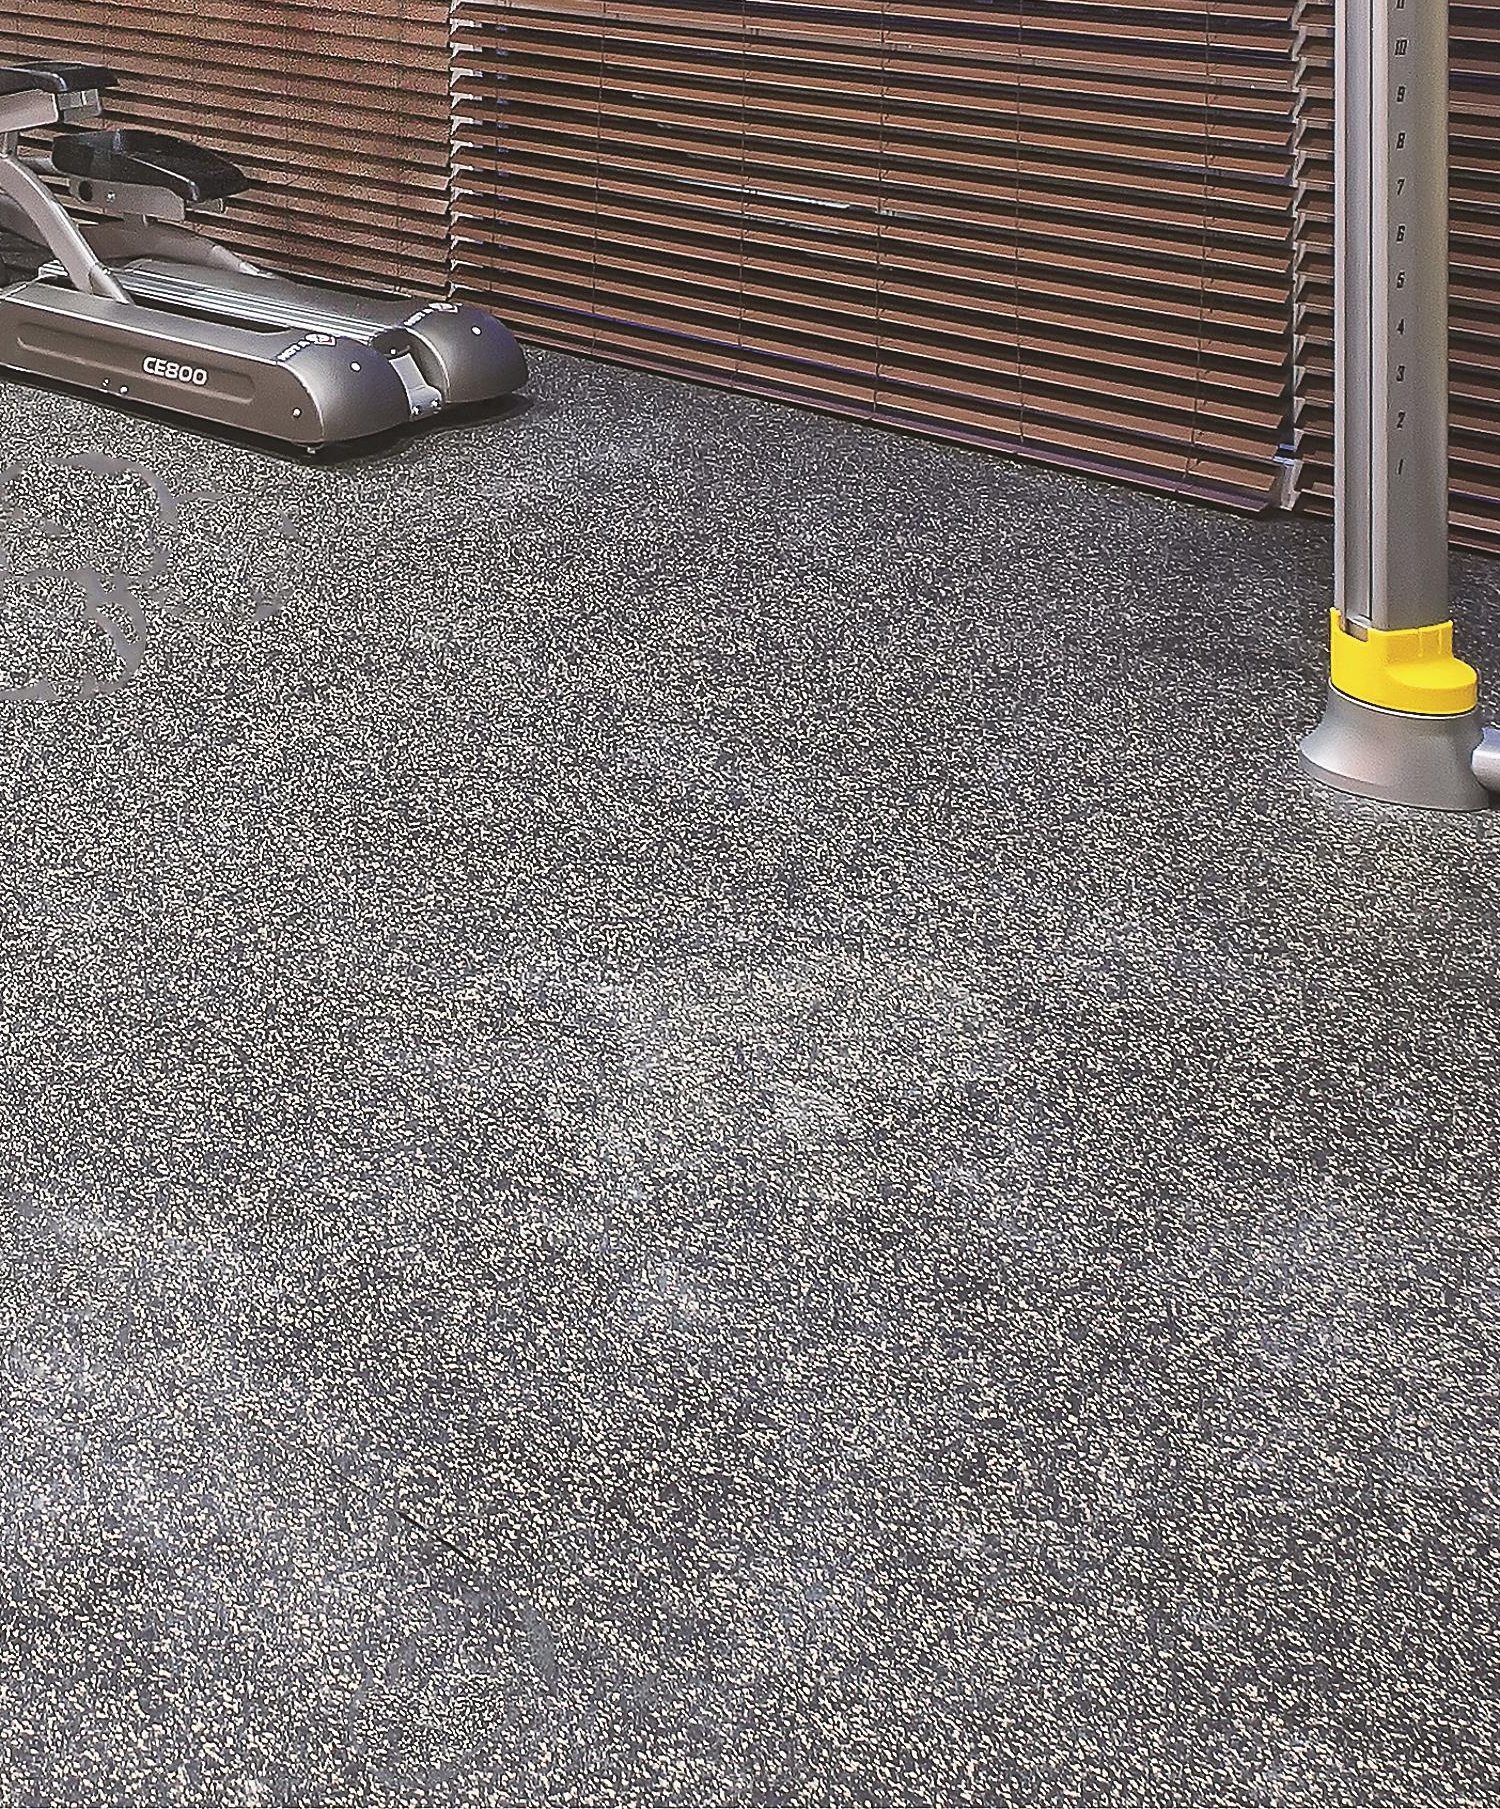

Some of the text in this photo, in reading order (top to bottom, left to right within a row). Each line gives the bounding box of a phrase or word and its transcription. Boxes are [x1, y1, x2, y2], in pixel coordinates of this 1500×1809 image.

[1393, 37, 1408, 56] 10
[1396, 85, 1406, 103] 9
[1396, 132, 1406, 149] 8
[1397, 178, 1405, 196] 7
[1395, 225, 1406, 242] 6
[1396, 271, 1406, 289] 5
[1396, 318, 1405, 335] 4
[142, 356, 207, 386] CE800
[1396, 365, 1406, 382] 3
[1396, 411, 1406, 429] 2
